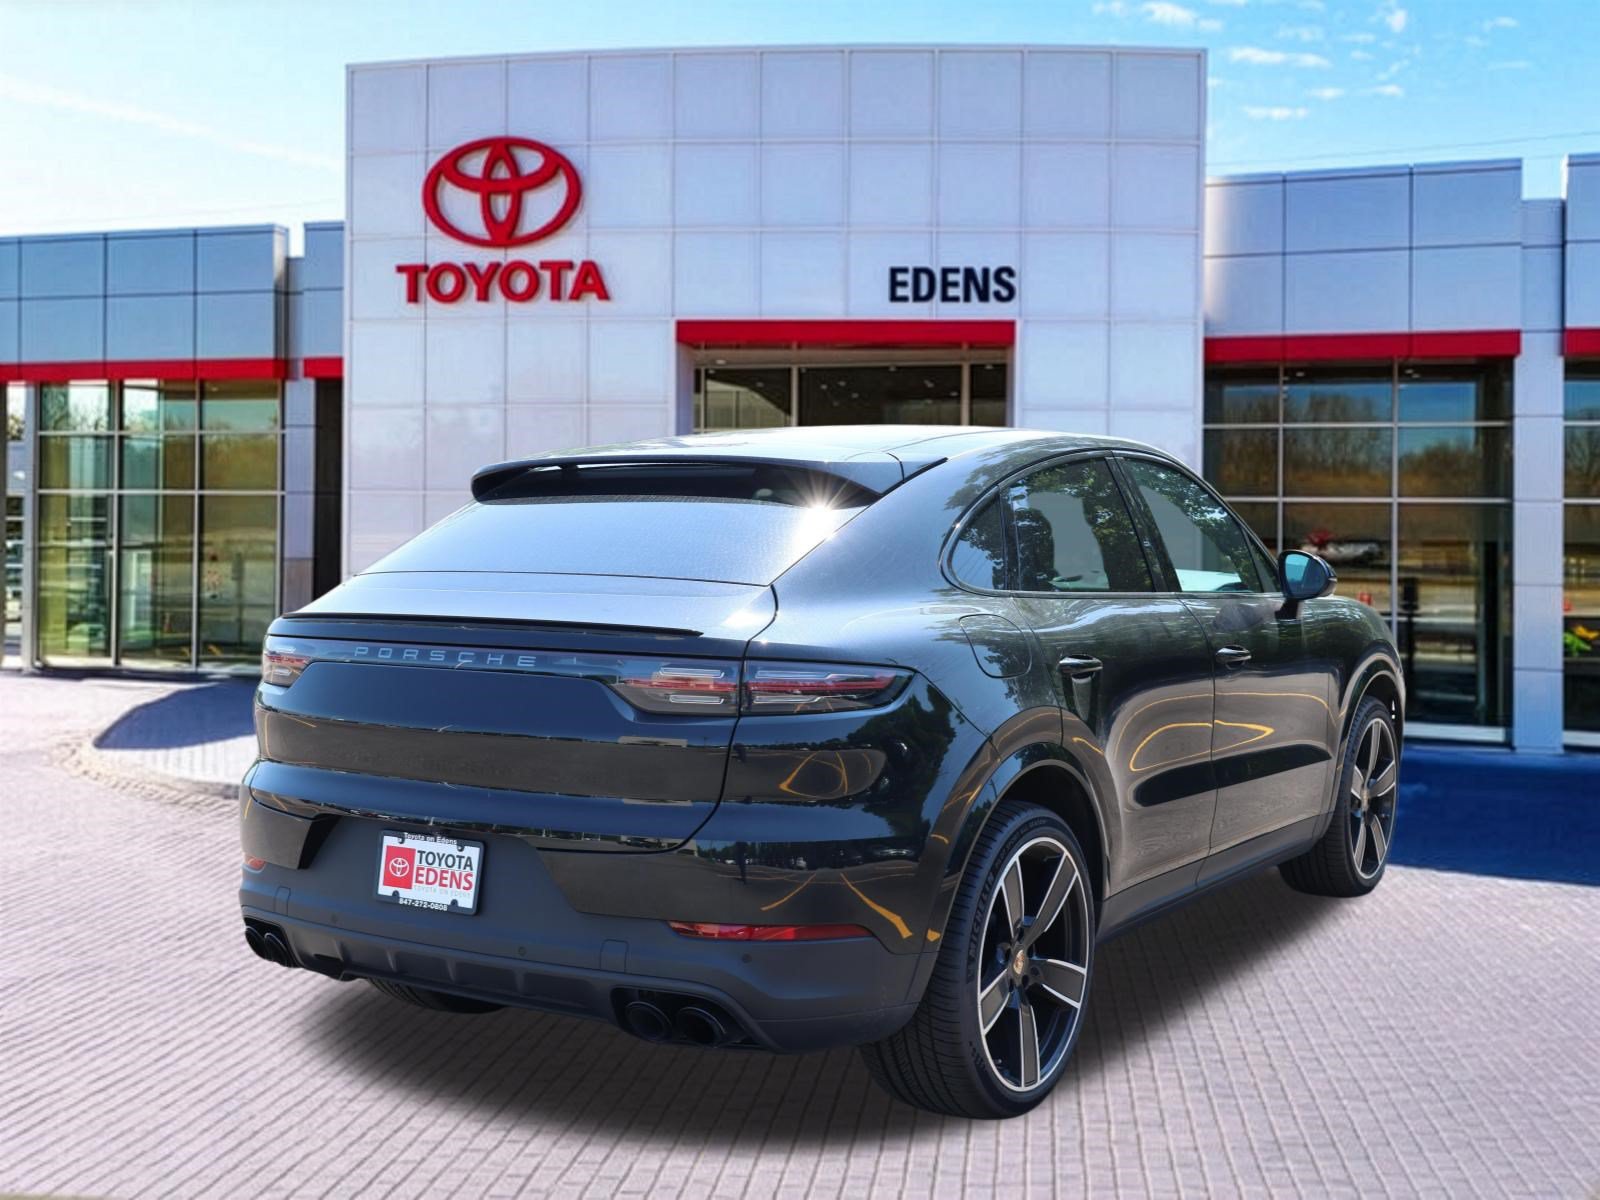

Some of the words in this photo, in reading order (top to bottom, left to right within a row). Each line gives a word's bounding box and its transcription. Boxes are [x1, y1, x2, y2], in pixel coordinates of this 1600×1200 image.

[396, 260, 610, 304] TOYOTA
[889, 266, 1016, 303] EDENS
[354, 647, 536, 666] PORSCHE
[404, 832, 425, 842] Toyota
[436, 836, 457, 845] Edens
[417, 850, 473, 871] TOYOTA
[415, 867, 473, 891] EDENS
